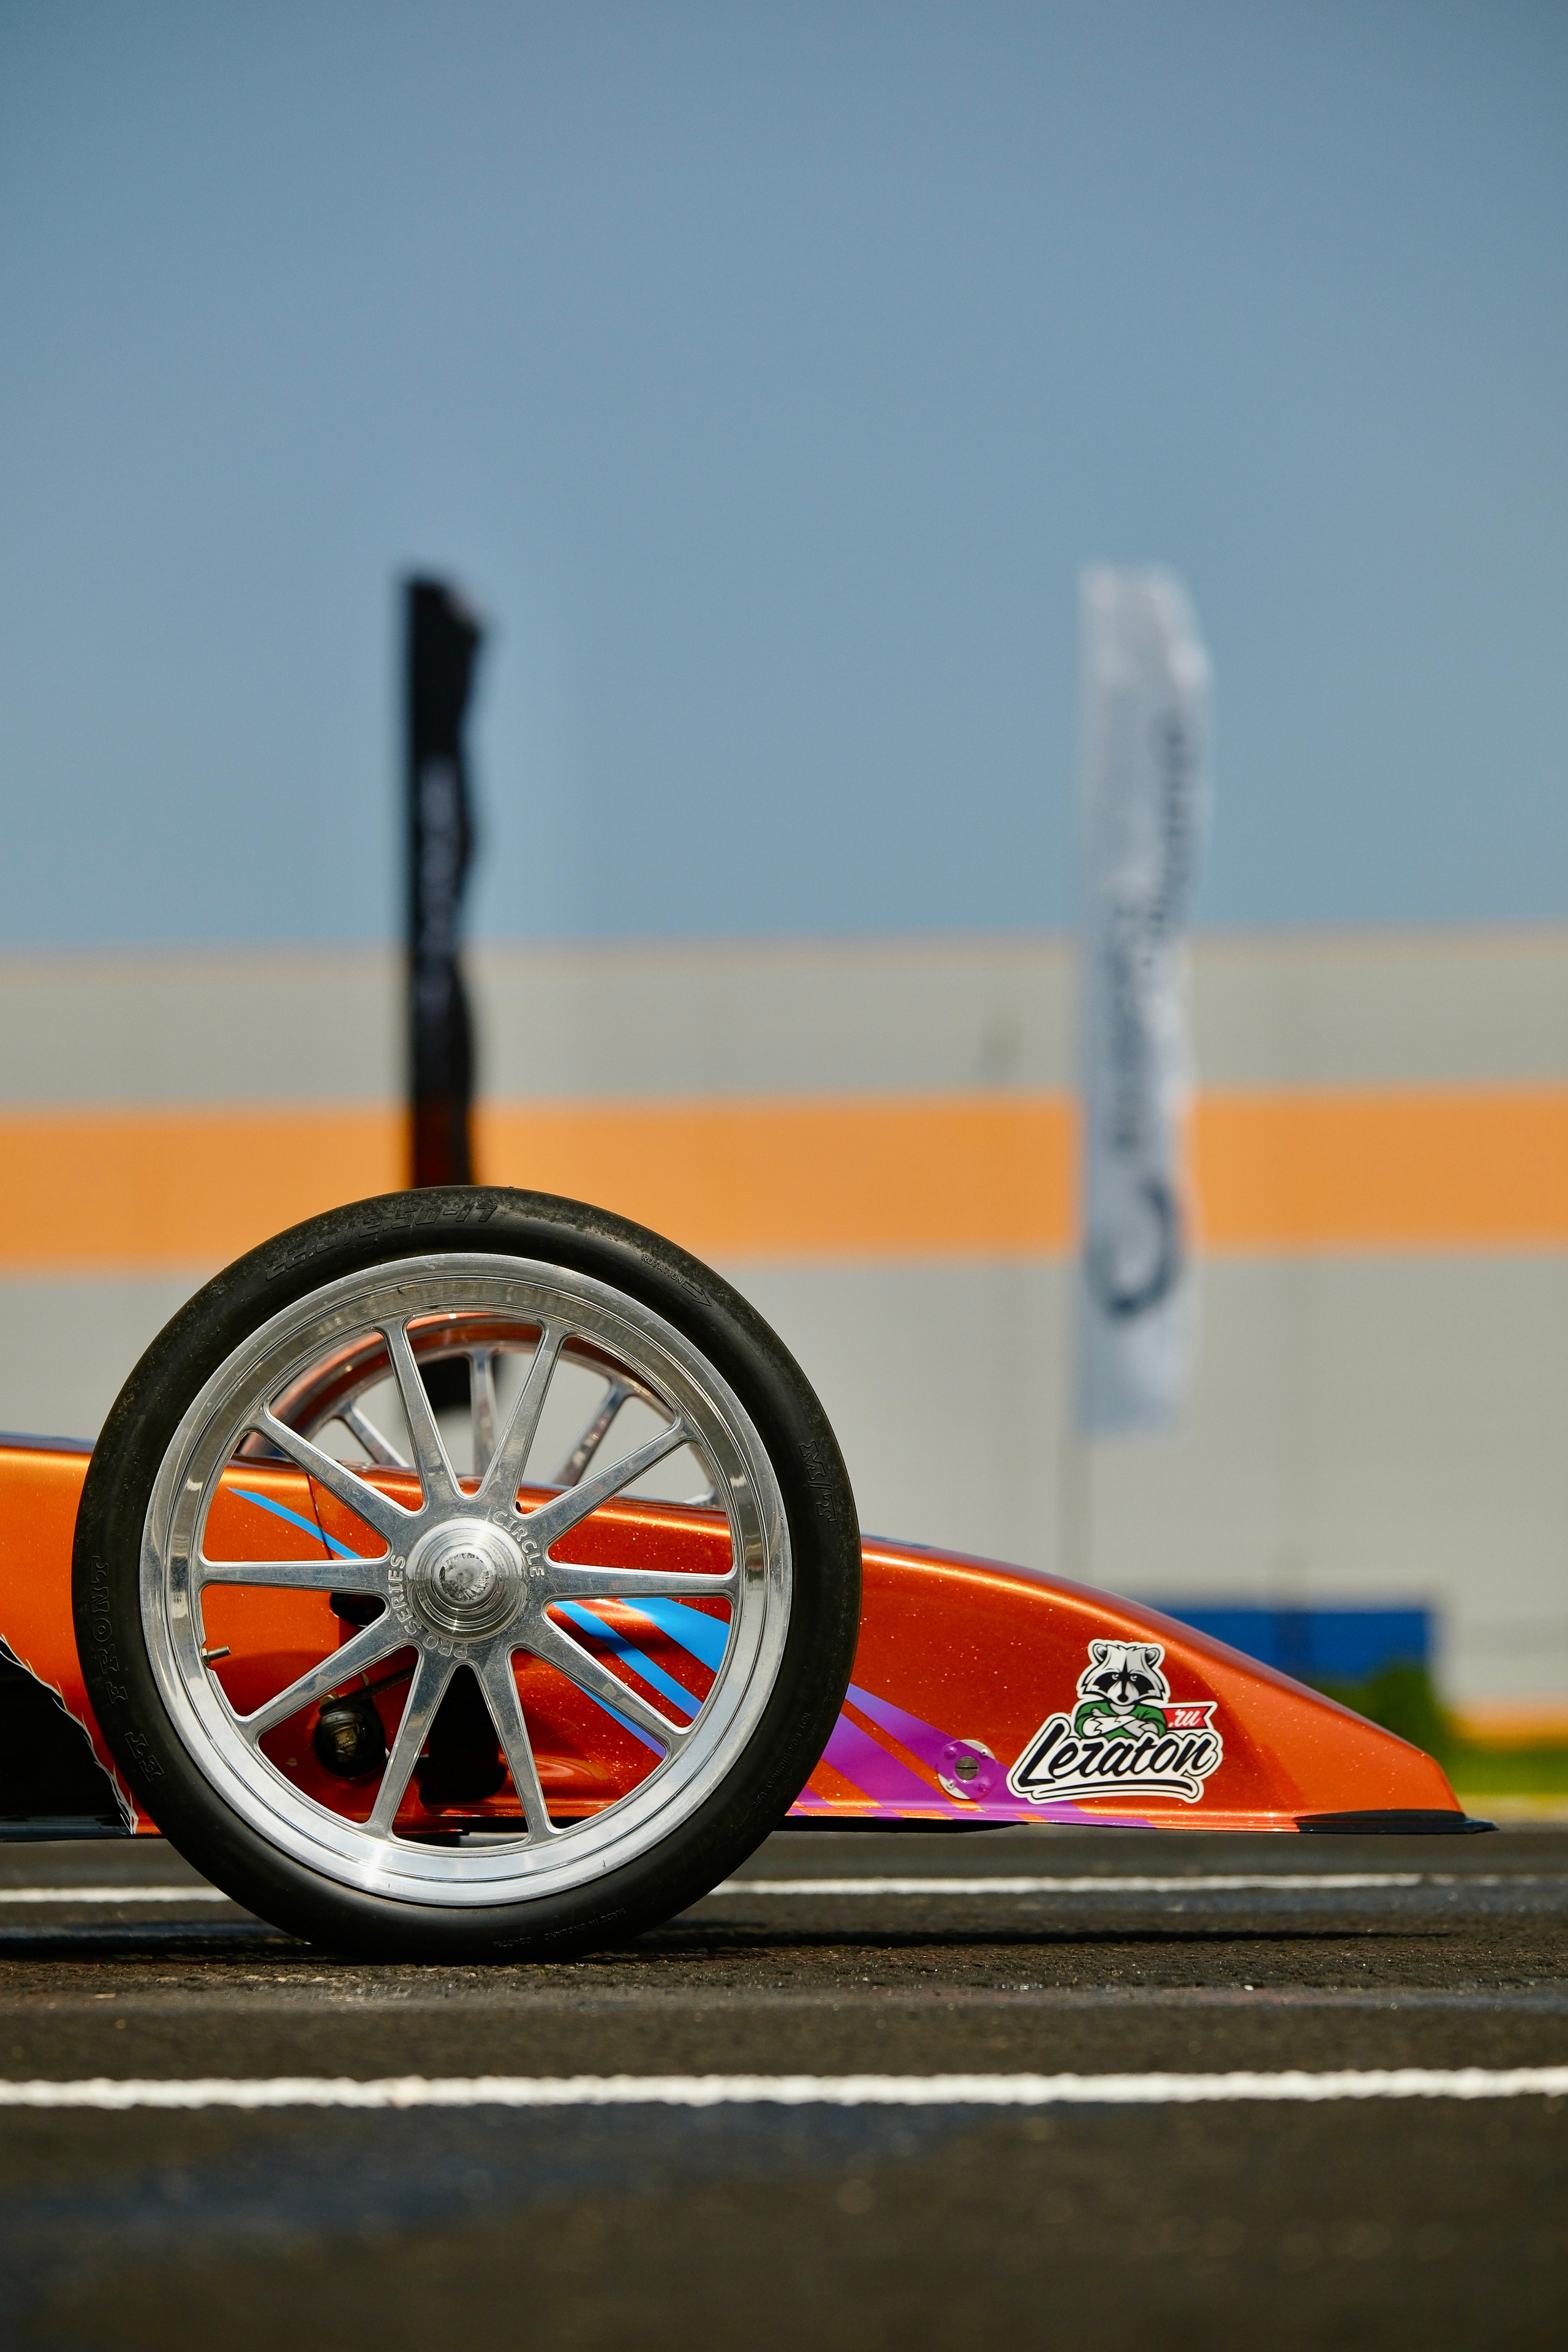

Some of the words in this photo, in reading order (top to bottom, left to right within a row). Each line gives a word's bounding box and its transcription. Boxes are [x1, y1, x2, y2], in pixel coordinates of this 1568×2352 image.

[641, 1254, 684, 1284] ROTATION
[799, 1441, 837, 1523] M/T
[492, 1509, 545, 1577] CIRCLE
[388, 1554, 422, 1635] SERIES
[91, 1555, 128, 1704] FRONT
[422, 1633, 468, 1659] PRO
[797, 1711, 812, 1731] NOT
[1168, 1708, 1201, 1728] .ru
[125, 1731, 164, 1782] ET
[750, 1790, 767, 1809] USE
[600, 1907, 626, 1923] MADE
[543, 1923, 586, 1940] ENGLAND
